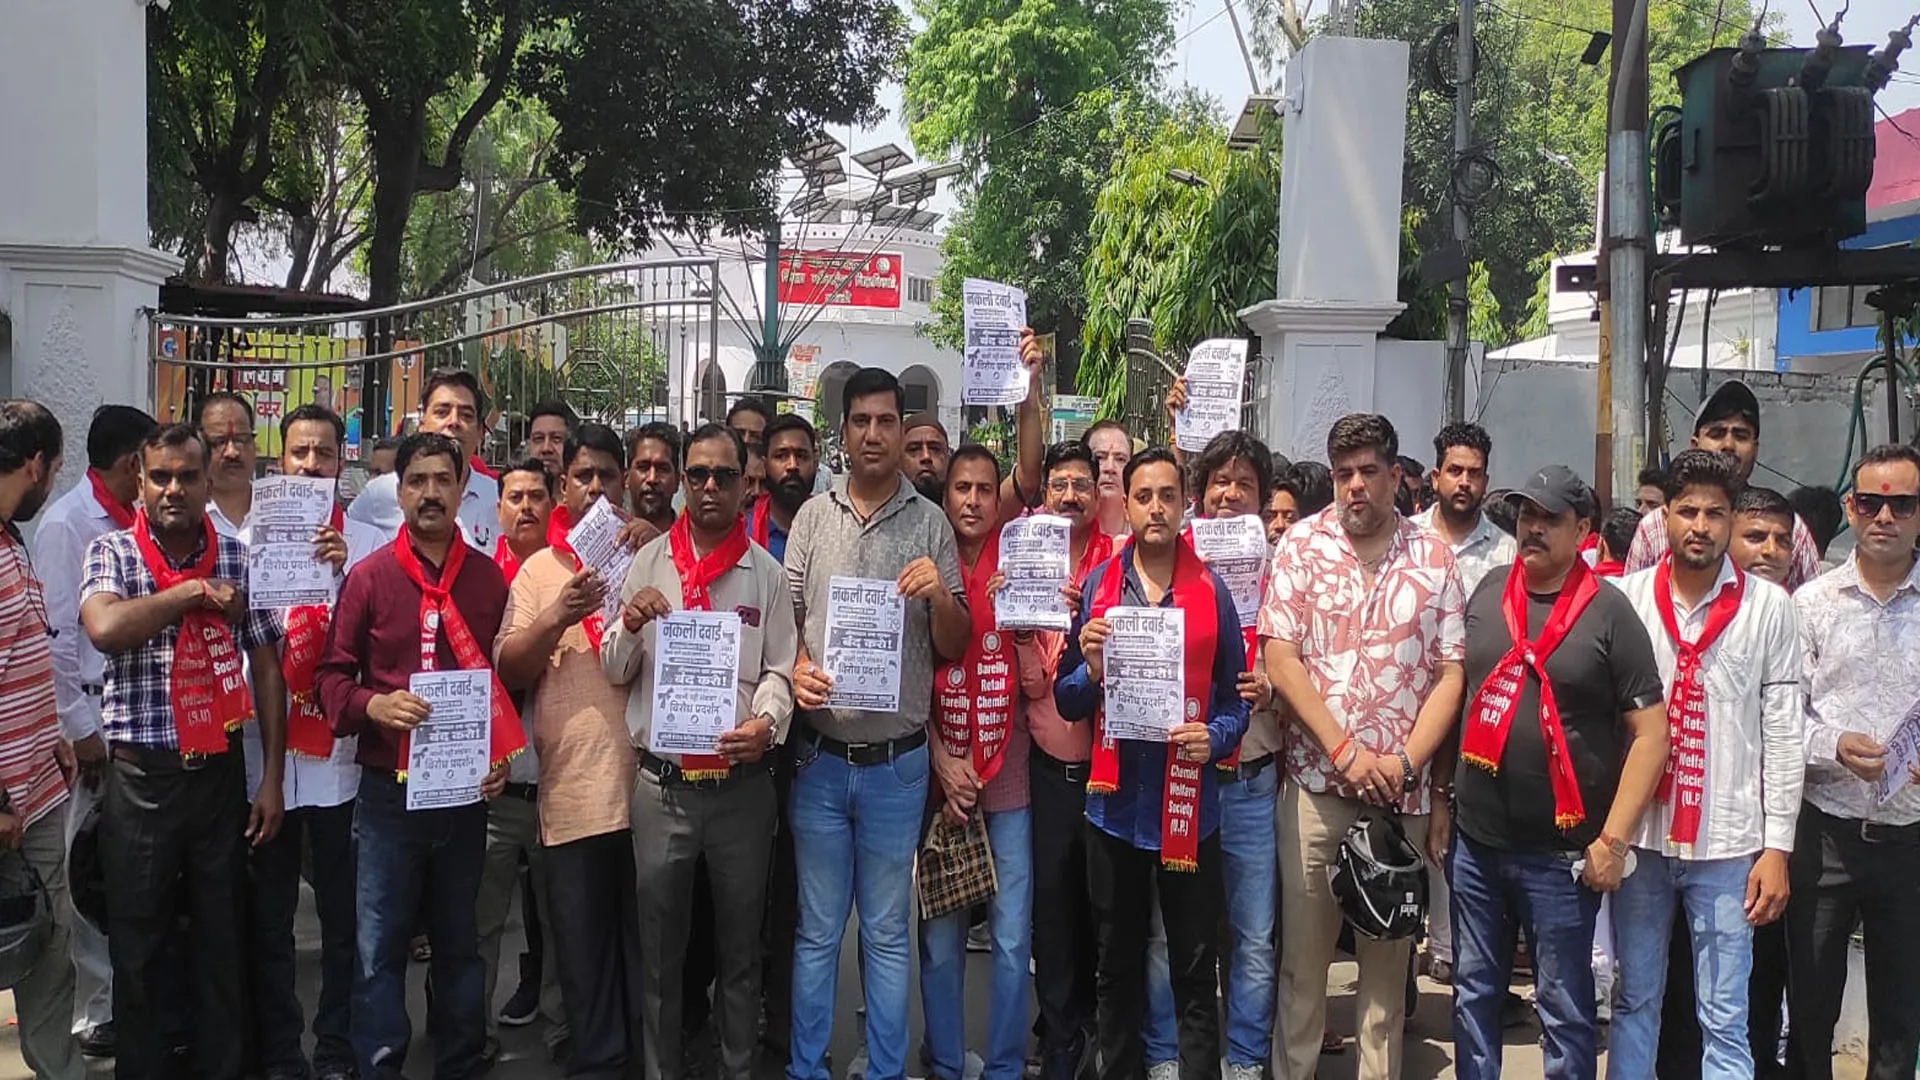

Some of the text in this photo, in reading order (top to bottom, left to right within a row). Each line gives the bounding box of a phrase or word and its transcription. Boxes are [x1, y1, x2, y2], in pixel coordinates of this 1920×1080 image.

[254, 480, 316, 500] नकली दवाई
[832, 583, 887, 606] नकली दवाई
[662, 619, 721, 642] नकली दवाई
[1141, 612, 1165, 634] दवाई
[977, 661, 1009, 676] Bareilly
[449, 674, 472, 697] दवाई
[981, 677, 1006, 692] Retail
[940, 695, 971, 711] Bareilly
[976, 694, 1009, 709] Chemist
[1481, 689, 1512, 713] Society
[943, 711, 967, 725] Retail
[977, 711, 1007, 725] Welfare
[1480, 707, 1502, 728] (U.P.)
[978, 729, 1006, 742] Society
[1170, 764, 1199, 780] Chemist
[1169, 782, 1196, 798] Welfare
[1167, 800, 1194, 818] Society
[1170, 818, 1189, 837] (U.P.)
